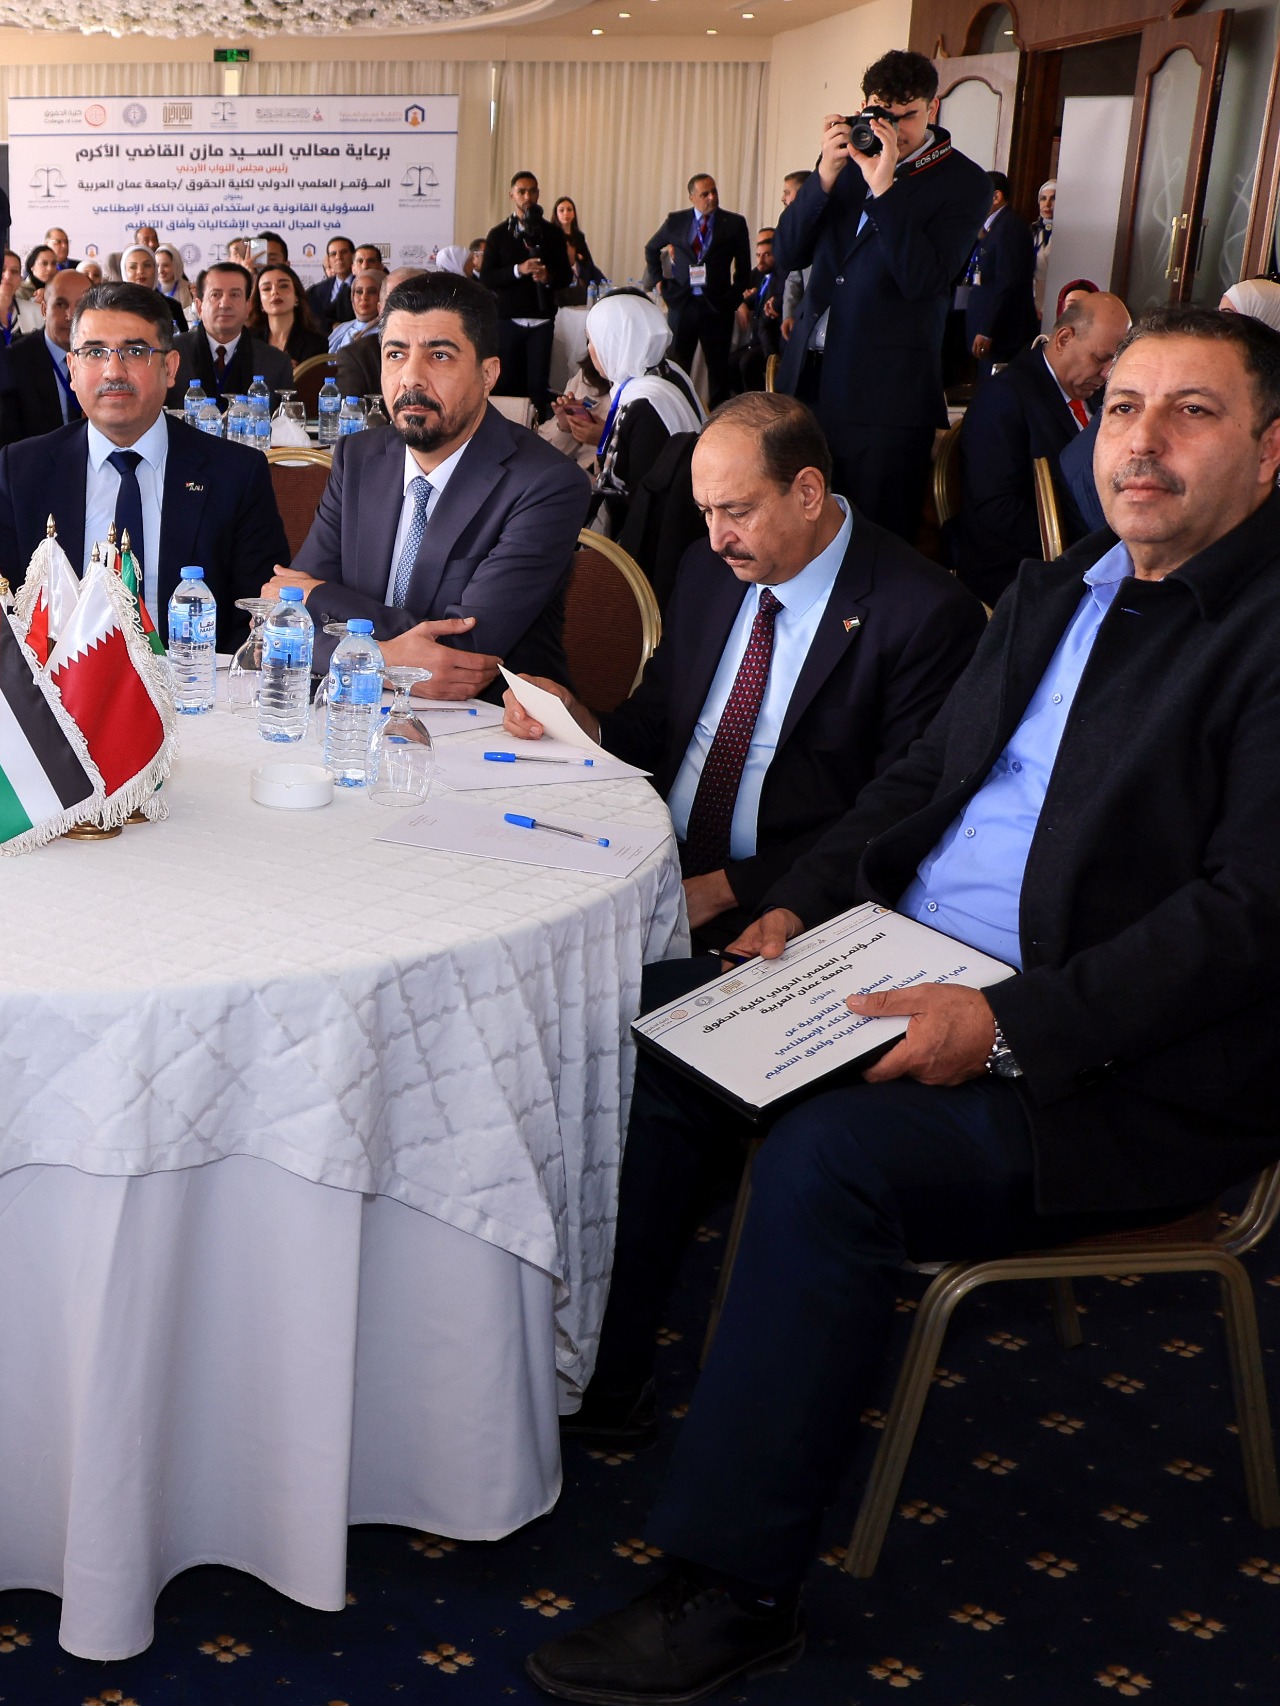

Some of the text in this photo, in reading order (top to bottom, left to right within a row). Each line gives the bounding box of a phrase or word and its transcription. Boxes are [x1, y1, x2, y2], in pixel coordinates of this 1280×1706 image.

[75, 143, 391, 162] برعاية معالي السيد مازن القاضي الأكرم
[915, 155, 932, 168] EOS
[176, 163, 288, 174] رئيس مجلس النواب الأردني
[77, 180, 114, 191] العربية
[116, 180, 142, 191] عمان
[185, 179, 225, 191] الحقوق
[228, 179, 254, 191] لكلية
[257, 178, 294, 191] الدولي
[297, 178, 337, 191] العلمي
[340, 178, 391, 191] المؤتمر
[92, 203, 375, 215] المسؤولية القانونية عن استخدام تقنيات الذكاء الإصطناعي
[166, 218, 196, 231] وآفاق
[197, 219, 249, 232] الإشكاليات
[251, 219, 286, 230] الصحي
[288, 219, 321, 231] المجال
[324, 219, 341, 230] في
[841, 932, 886, 960] المؤتمر
[802, 957, 840, 979] العلمي
[948, 965, 968, 977] في
[759, 963, 853, 1015] جامعة عمان العربية
[767, 977, 802, 999] الدولي
[809, 988, 836, 1005] بعنوان
[741, 996, 766, 1013] لكلية
[702, 1010, 740, 1034] الحقوق
[799, 1002, 842, 1029] القانونية
[784, 1026, 799, 1038] عن
[804, 1038, 834, 1059] وآفاق
[764, 1054, 803, 1081] التنظيم
